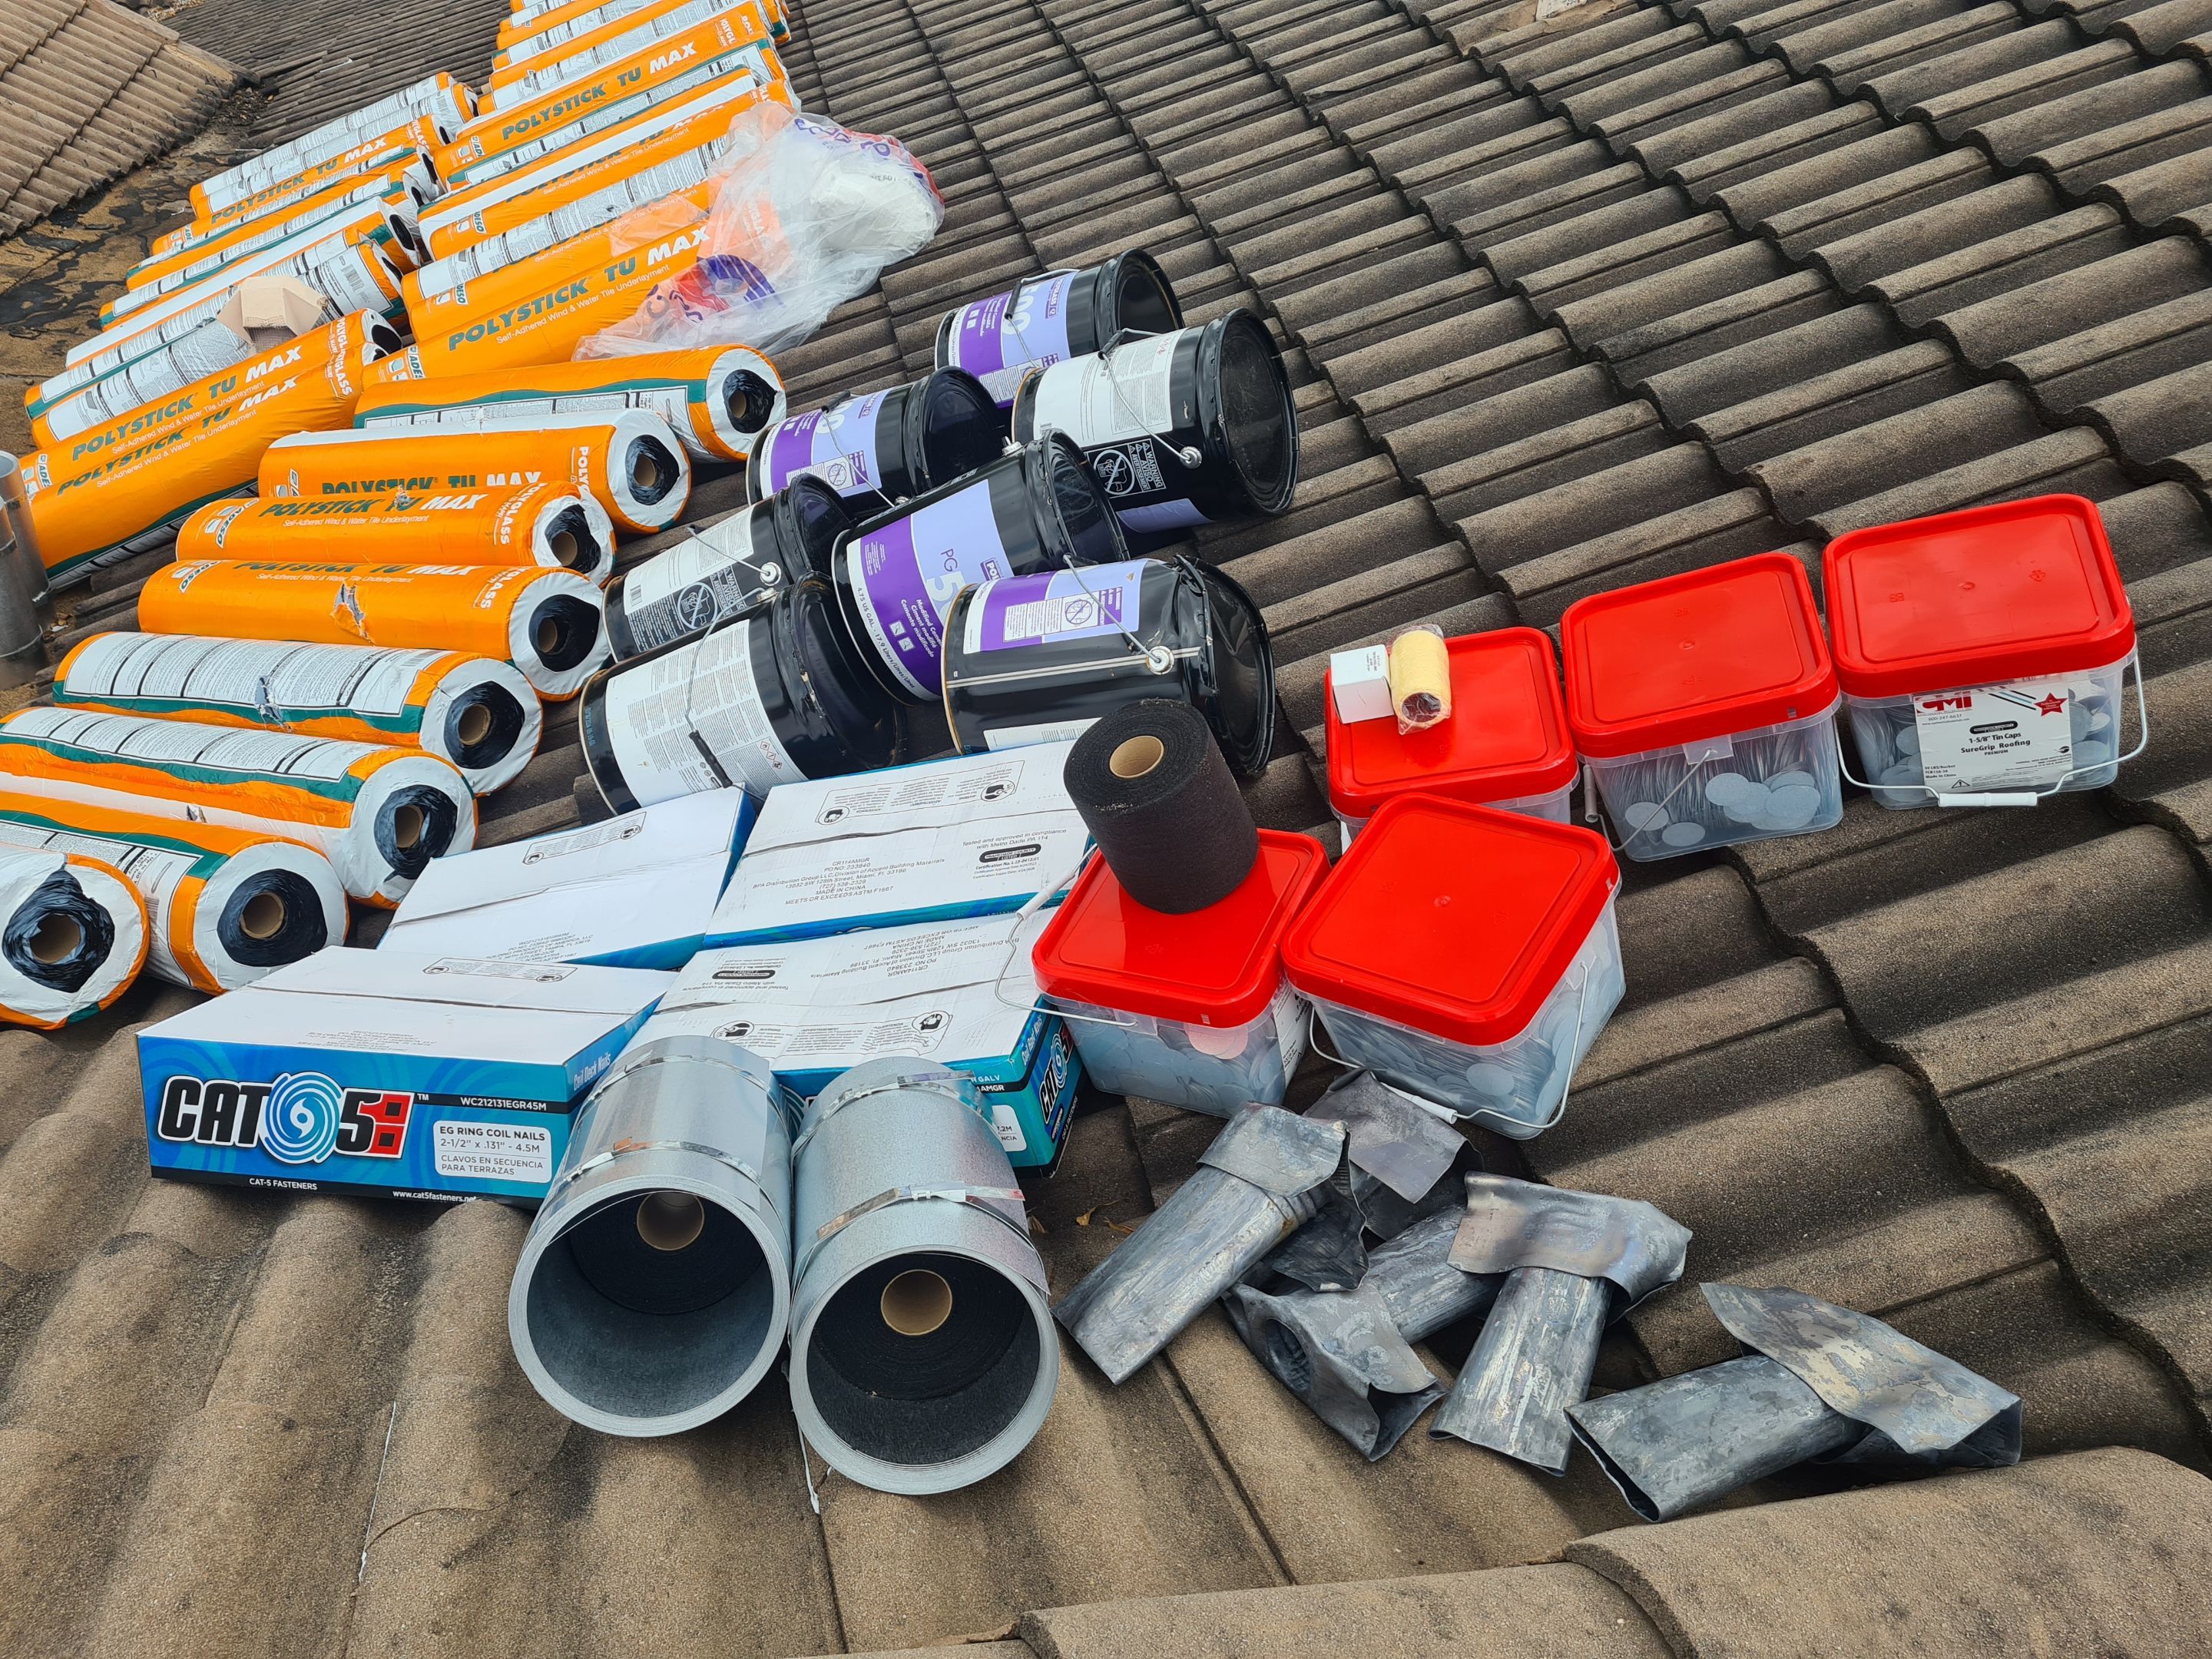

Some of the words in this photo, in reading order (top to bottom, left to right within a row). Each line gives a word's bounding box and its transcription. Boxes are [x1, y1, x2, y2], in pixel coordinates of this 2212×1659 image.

[502, 82, 604, 141] POLYSTICK
[617, 67, 641, 87] TU
[649, 41, 697, 75] MAX
[544, 174, 586, 195] Self-Adhered
[611, 154, 630, 166] Water
[631, 147, 643, 156] Tile
[644, 127, 689, 152] Underlayment
[211, 166, 306, 224] POLYSTICK
[316, 158, 338, 175] TU
[344, 137, 388, 164] MAX
[449, 278, 590, 350] POLYSTICK
[604, 257, 637, 283] TU
[647, 225, 711, 266] MAX
[496, 317, 547, 344] Self-Adhered
[549, 306, 569, 322] Wind
[576, 293, 599, 310] Water
[601, 285, 615, 299] Tile
[615, 263, 671, 293] Underlayment
[72, 394, 194, 461] POLYSTICK
[208, 376, 237, 400] TU
[244, 346, 303, 383] MAX
[112, 432, 155, 455] Self-Adhered
[156, 422, 174, 436] Wind
[182, 409, 203, 424] Water
[203, 401, 216, 416] Tile
[217, 379, 265, 409] Underlayment
[57, 427, 187, 497] POLYSTICK
[201, 406, 232, 430] TU
[238, 374, 300, 413] MAX
[97, 465, 143, 488] Self-Adhered
[143, 454, 162, 469] Wind
[170, 439, 191, 455] Water
[193, 430, 206, 444] Tile
[207, 408, 257, 440] Underlayment
[1140, 460, 1154, 482] AVISO
[1147, 452, 1164, 488] WARNING
[258, 499, 378, 518] POLYSTICK
[419, 494, 488, 511] MAX
[217, 506, 245, 546] ADESO
[283, 516, 323, 527] Self-Adhered
[324, 515, 340, 525] Wind
[348, 515, 369, 525] Water
[369, 515, 381, 524] Tile
[381, 515, 429, 525] Underlayment
[406, 565, 485, 575] MAX
[940, 548, 958, 572] PG
[857, 587, 866, 603] 4.75
[861, 602, 870, 614] US
[911, 604, 924, 627] Ciment
[916, 598, 932, 628] Modified
[901, 599, 916, 627] Cemento
[913, 626, 935, 658] modificado
[875, 633, 886, 648] 17.9
[1961, 743, 1995, 754] SureGrip
[1999, 739, 2031, 750] Roofing
[2004, 732, 2022, 741] Caps
[1031, 830, 1067, 838] compliance
[766, 878, 800, 887] Distribution
[916, 858, 945, 866] Materials
[820, 892, 853, 900] EXCEEDS
[853, 888, 873, 896] ASTM
[924, 935, 945, 943] MADE
[965, 939, 1004, 950] Distribution
[841, 965, 868, 974] Building
[574, 1068, 584, 1091] Coil
[584, 1060, 598, 1083] Deck
[598, 1051, 611, 1072] Nails
[157, 1075, 272, 1148] CAT
[460, 1096, 547, 1111] WC212131EGR45M
[439, 1126, 454, 1134] EG
[457, 1128, 484, 1137] RING
[486, 1128, 512, 1139] COIL
[514, 1131, 545, 1141] NAILS
[515, 1143, 540, 1154] 4.5M
[441, 1154, 476, 1164] CLAVOS
[479, 1157, 491, 1165] EN
[493, 1157, 544, 1170] SECUENCIA
[441, 1164, 466, 1172] PARA
[469, 1164, 515, 1176] TERRAZAS
[249, 1177, 272, 1187] CAT-5
[273, 1179, 318, 1190] FASTENERS
